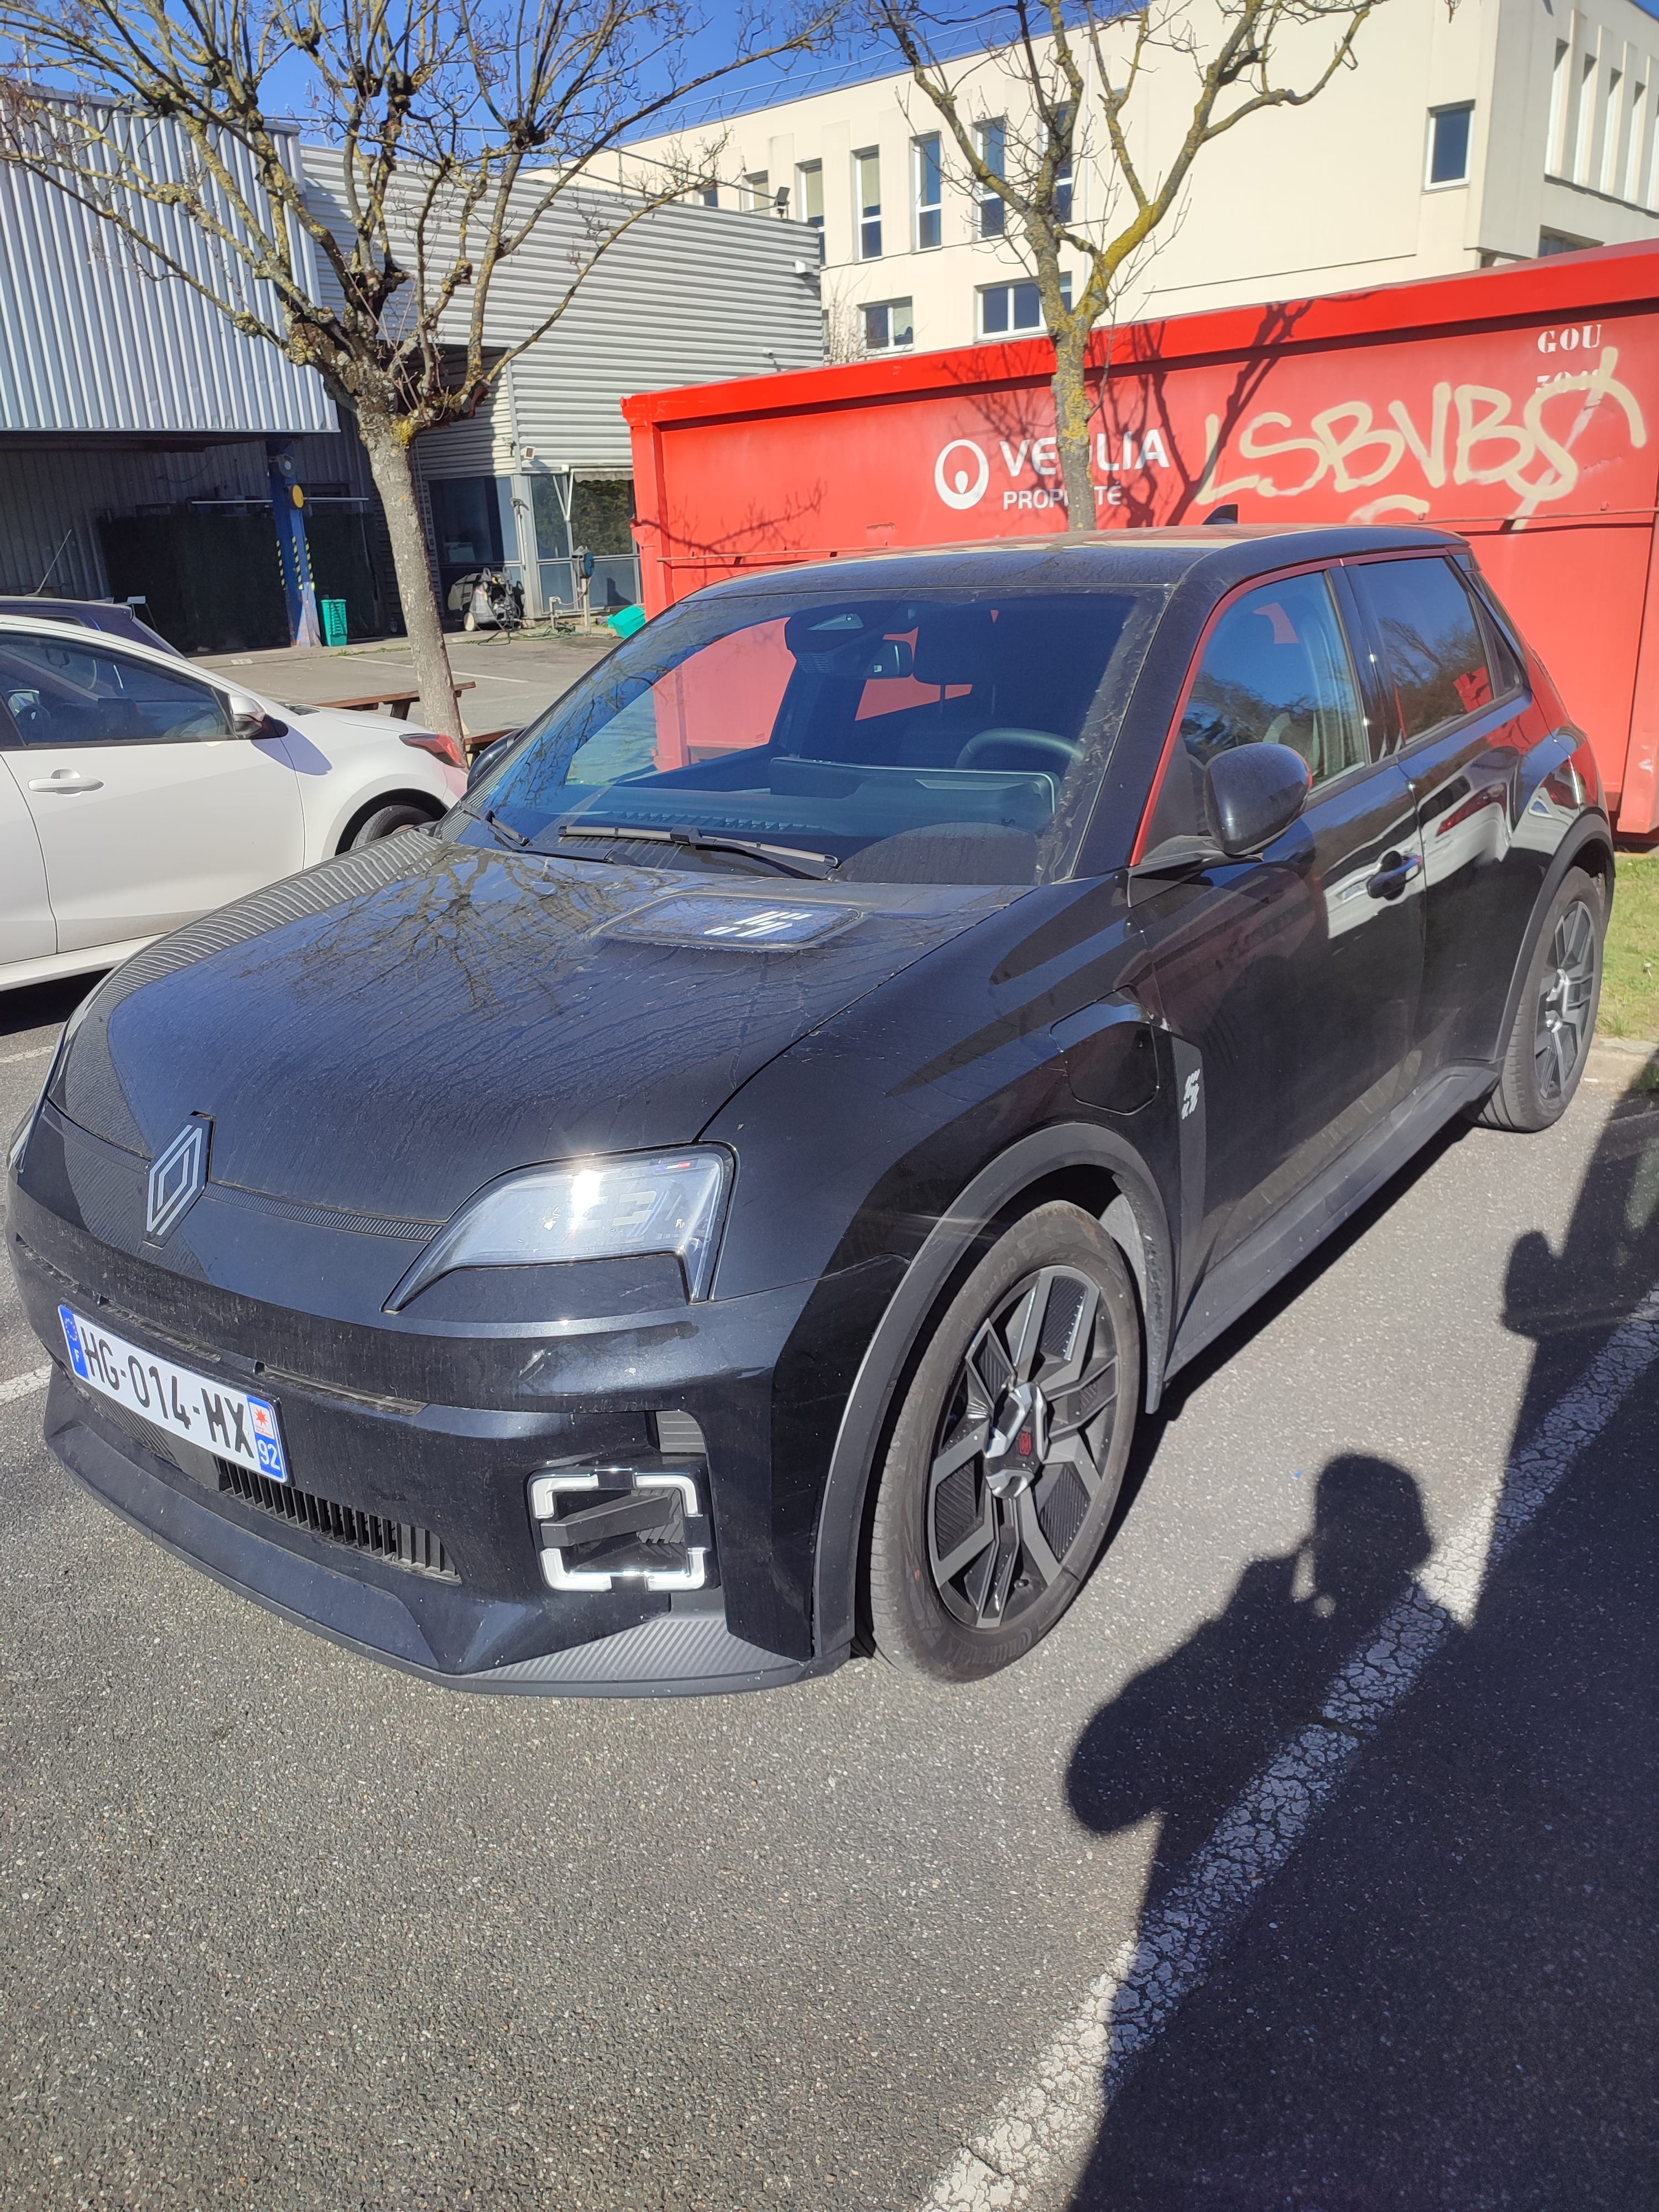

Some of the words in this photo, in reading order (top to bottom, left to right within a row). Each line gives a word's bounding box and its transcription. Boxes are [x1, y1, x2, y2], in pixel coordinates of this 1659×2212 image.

[1537, 324, 1602, 353] GOU
[999, 429, 1170, 477] VELIA
[1003, 481, 1123, 510] PROPTÉ
[74, 1348, 80, 1363] F
[80, 1326, 255, 1459] HG-014-MX
[258, 1439, 280, 1470] 92
